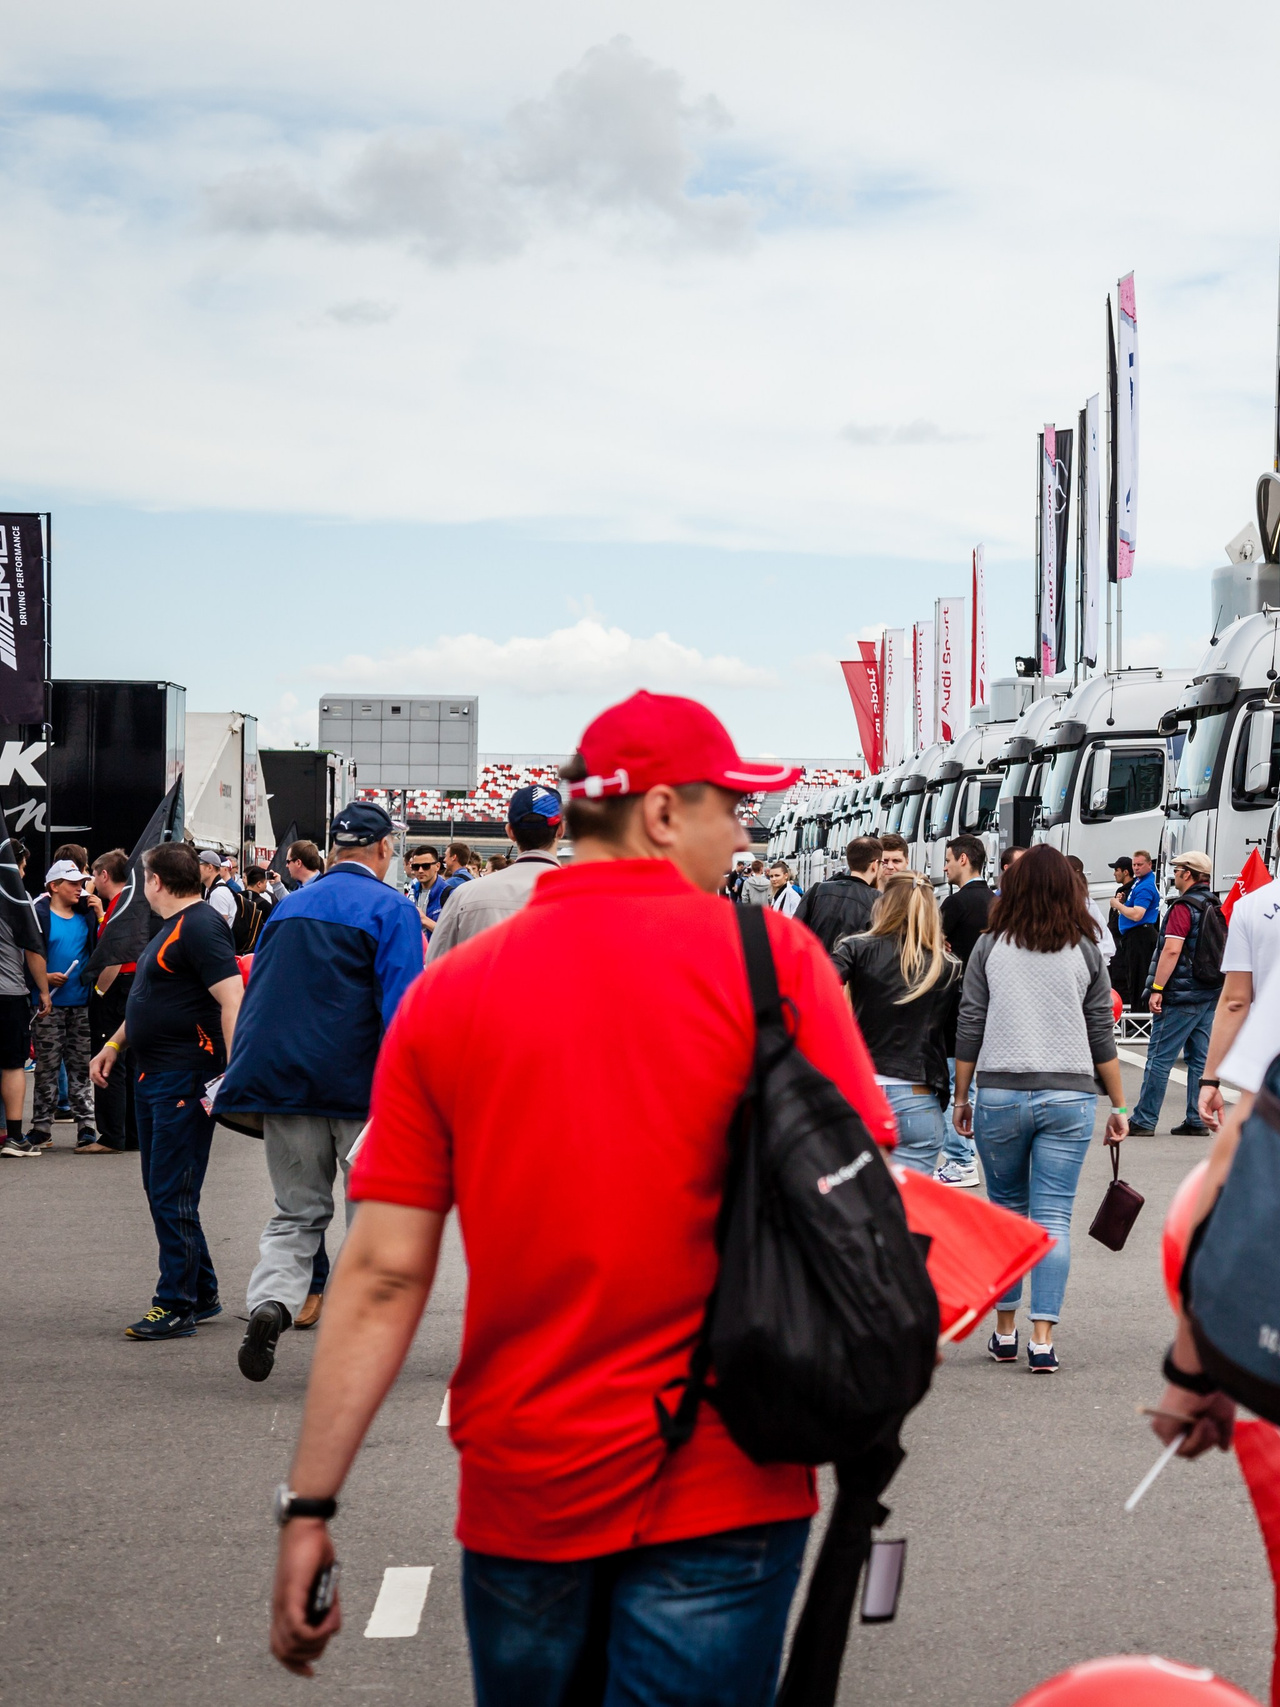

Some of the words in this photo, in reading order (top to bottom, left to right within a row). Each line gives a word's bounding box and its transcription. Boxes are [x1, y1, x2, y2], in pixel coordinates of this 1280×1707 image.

[12, 525, 25, 589] PERFORMANCE
[17, 590, 28, 626] DRIVING
[941, 671, 951, 716] Audi
